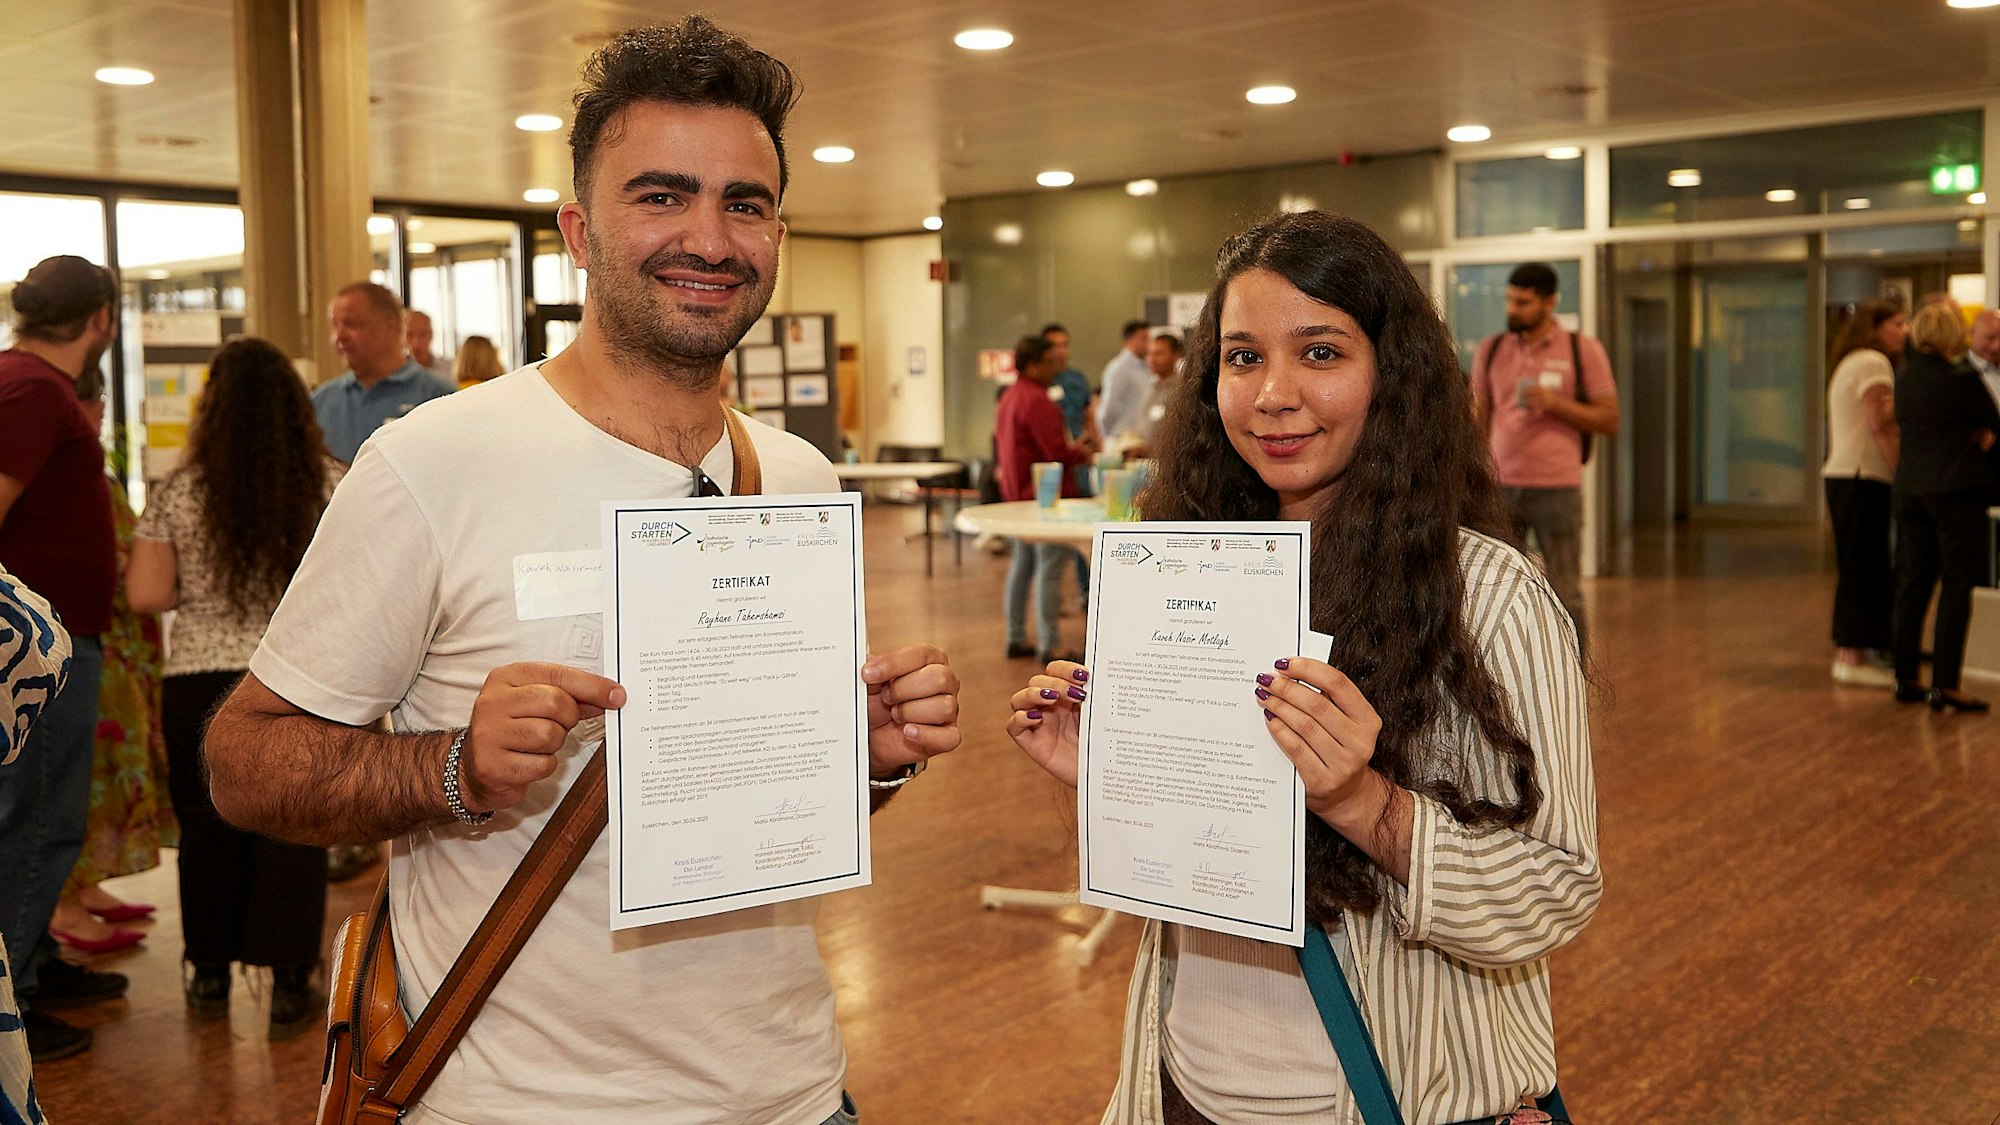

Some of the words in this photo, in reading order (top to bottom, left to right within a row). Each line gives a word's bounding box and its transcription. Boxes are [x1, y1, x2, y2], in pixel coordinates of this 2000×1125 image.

[641, 521, 674, 530] DURCH
[631, 530, 673, 539] STARTEN
[797, 539, 838, 547] EUSKIRCHEN
[1110, 550, 1139, 558] STARTEN
[712, 575, 771, 589] ZERTIFIKAT
[1166, 599, 1217, 612] ZERTIFIKAT
[697, 611, 731, 628] Rayhane
[1151, 629, 1173, 641] Kaveh
[1175, 630, 1196, 644] Nasir
[1198, 632, 1229, 650] Motlagh
